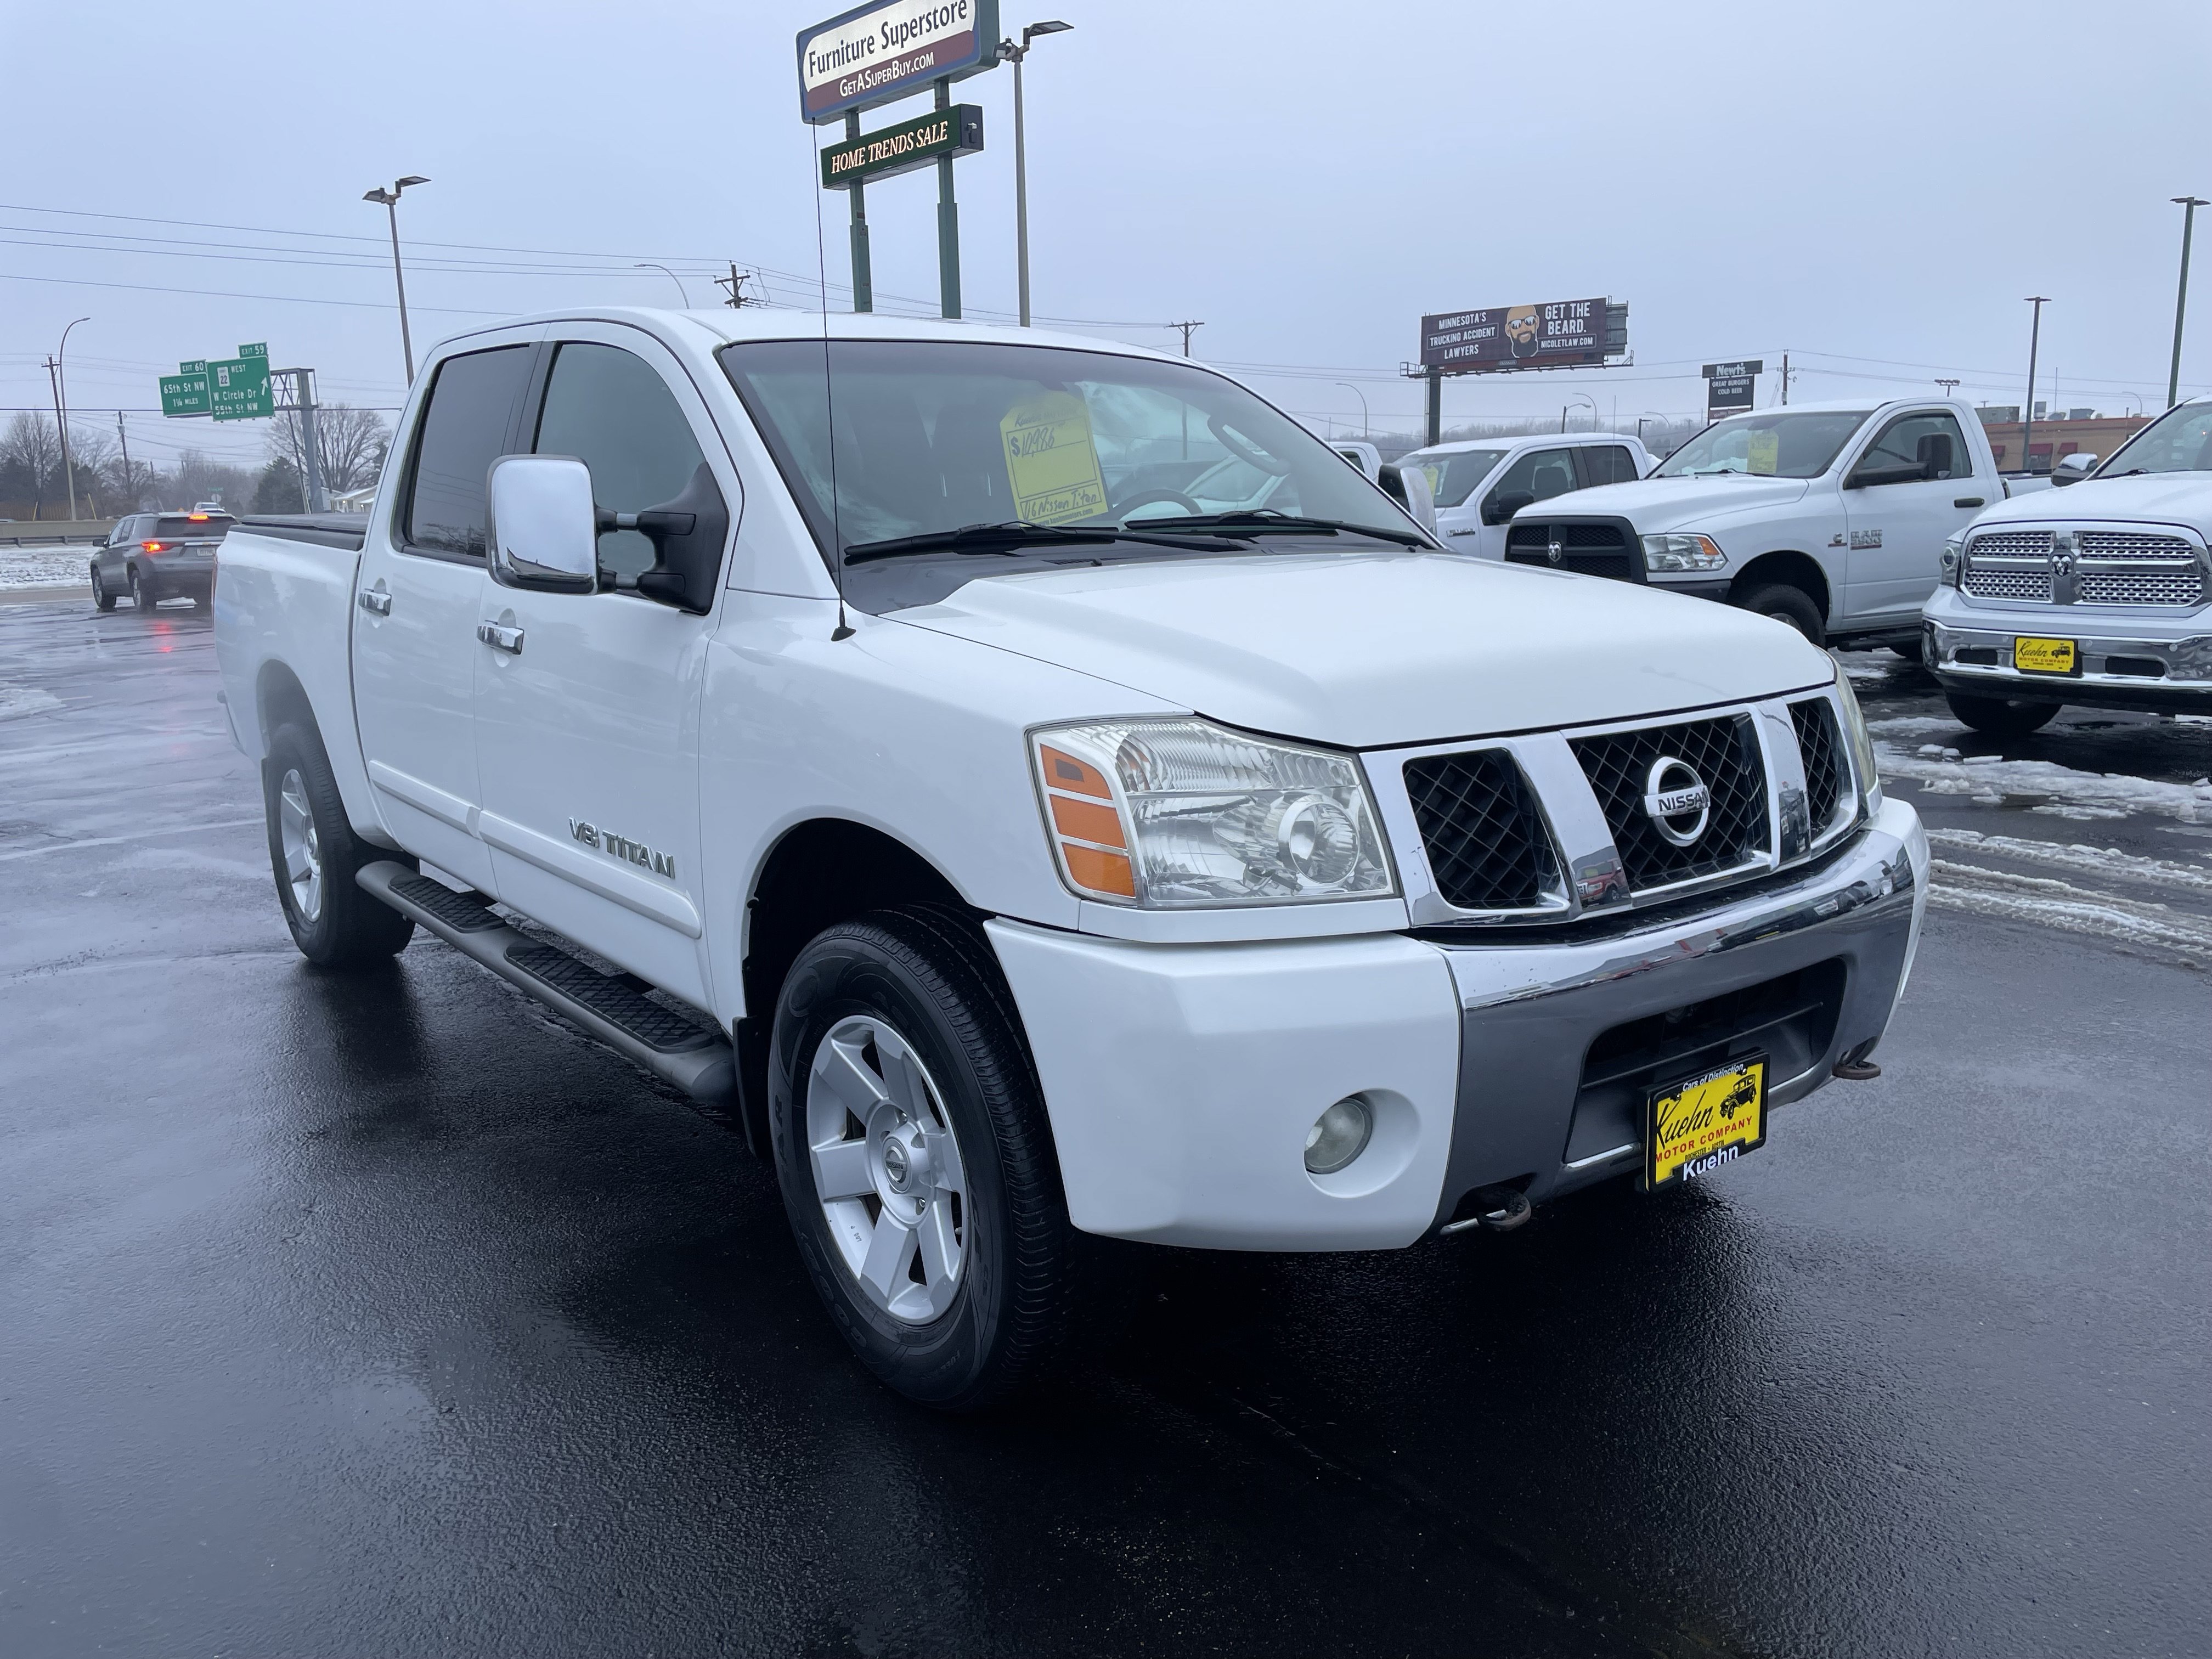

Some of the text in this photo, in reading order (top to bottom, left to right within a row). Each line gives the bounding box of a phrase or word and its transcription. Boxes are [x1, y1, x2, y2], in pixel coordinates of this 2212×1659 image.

[809, 0, 968, 77] Furniture Superstore
[831, 121, 949, 174] HOME TRENDS SALE
[1545, 301, 1591, 320] GET THE
[1438, 311, 1487, 330] MINNESOTA'S
[1548, 318, 1587, 336] BEARD.
[1430, 326, 1496, 347] TRUCKING ACCIDENT
[1541, 337, 1594, 349] NICOLETLAW.COM
[255, 345, 264, 354] 59
[1444, 345, 1479, 359] LAWYERS
[194, 362, 204, 372] 60
[230, 364, 246, 373] WEST
[1716, 363, 1746, 376] Newt's
[163, 381, 205, 394] 65th St NW
[220, 375, 228, 384] 22
[213, 389, 256, 402] W Circle Dr
[215, 403, 258, 415] 55th St NW
[2017, 642, 2048, 657] Kuehn
[1658, 789, 1709, 812] NISSAN
[568, 817, 676, 879] V8 TITAN
[1682, 1063, 1744, 1092] Cars of Distinction
[1656, 1089, 1714, 1150] Kuehn
[1656, 1115, 1753, 1163] MOTOR COMPANY
[885, 1161, 904, 1170] SSAN
[1683, 1145, 1739, 1182] Kuehn
